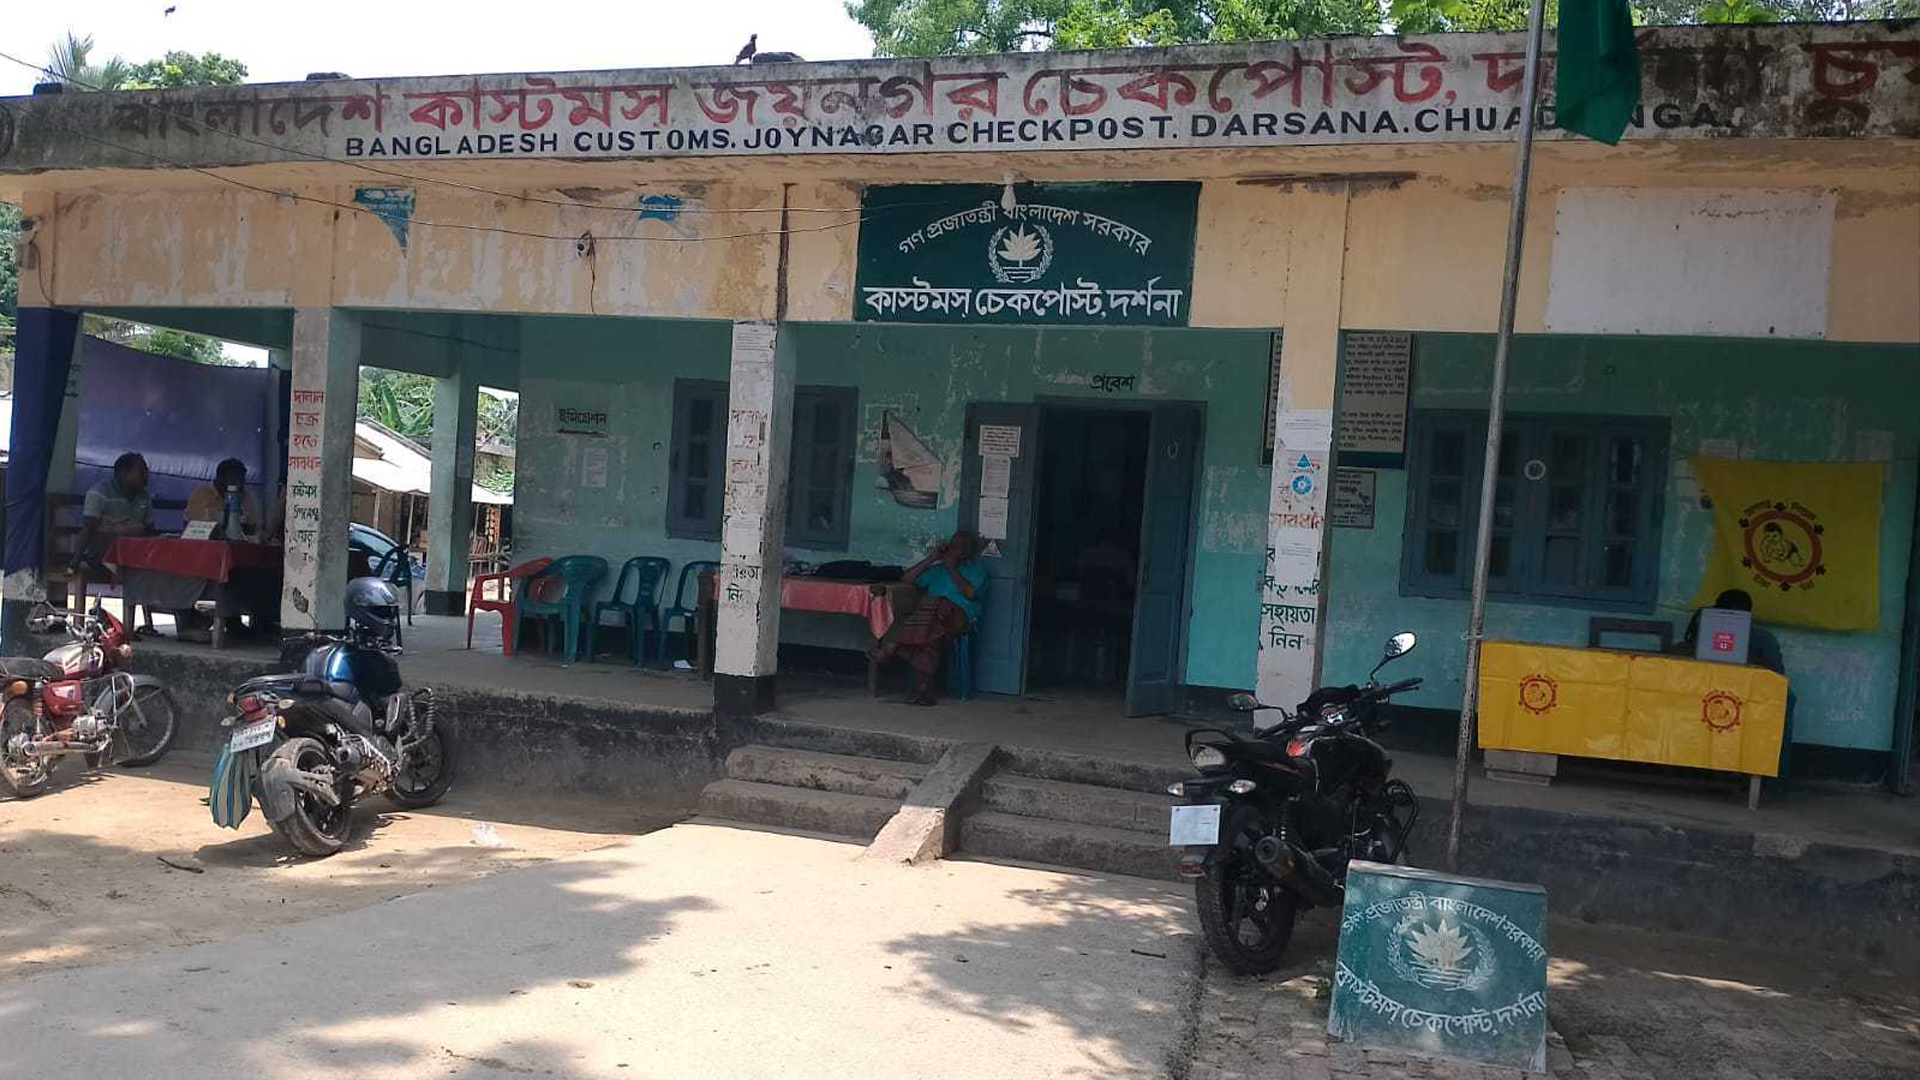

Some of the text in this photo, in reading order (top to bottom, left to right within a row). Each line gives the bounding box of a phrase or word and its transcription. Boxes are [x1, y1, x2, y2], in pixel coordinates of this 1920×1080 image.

[345, 132, 558, 157] BANGLADESH
[947, 115, 1178, 144] CHECKPOST.
[899, 200, 1152, 256] গণ প্রজাতন্ত্রী বাংলাদেশ সরকার
[1105, 276, 1183, 319] দর্শনা
[1261, 603, 1316, 625] সহায়তা
[1268, 626, 1304, 650] নিন
[1429, 895, 1505, 928] বাংলাদেশ
[1493, 991, 1546, 1026] দর্শনা
